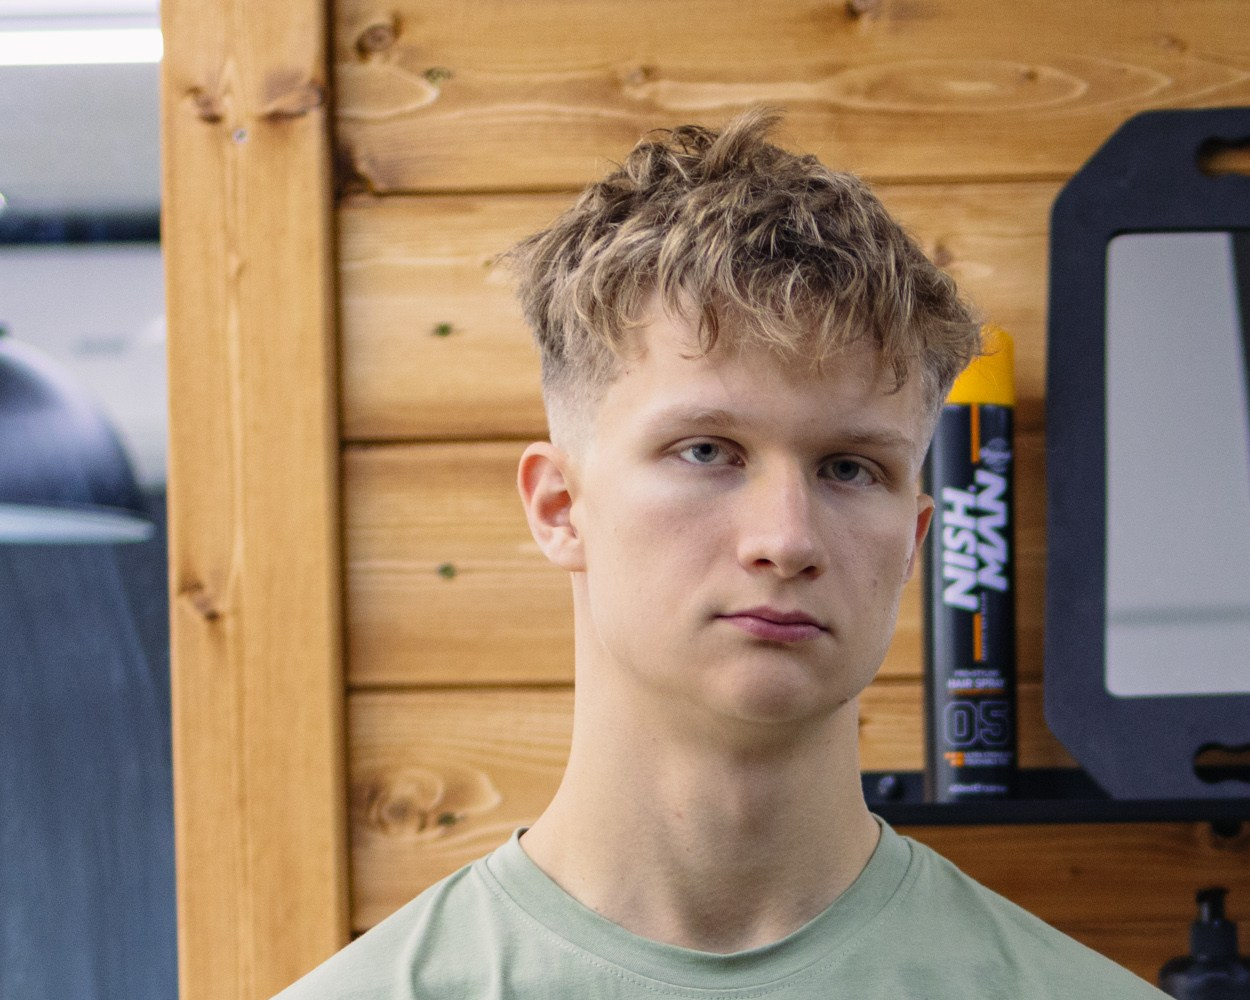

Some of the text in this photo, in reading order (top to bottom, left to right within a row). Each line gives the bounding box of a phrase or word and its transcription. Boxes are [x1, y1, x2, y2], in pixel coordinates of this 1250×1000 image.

[974, 468, 1009, 592] MAN
[947, 678, 1005, 689] HAIR SPRAY
[943, 700, 1009, 746] 05
